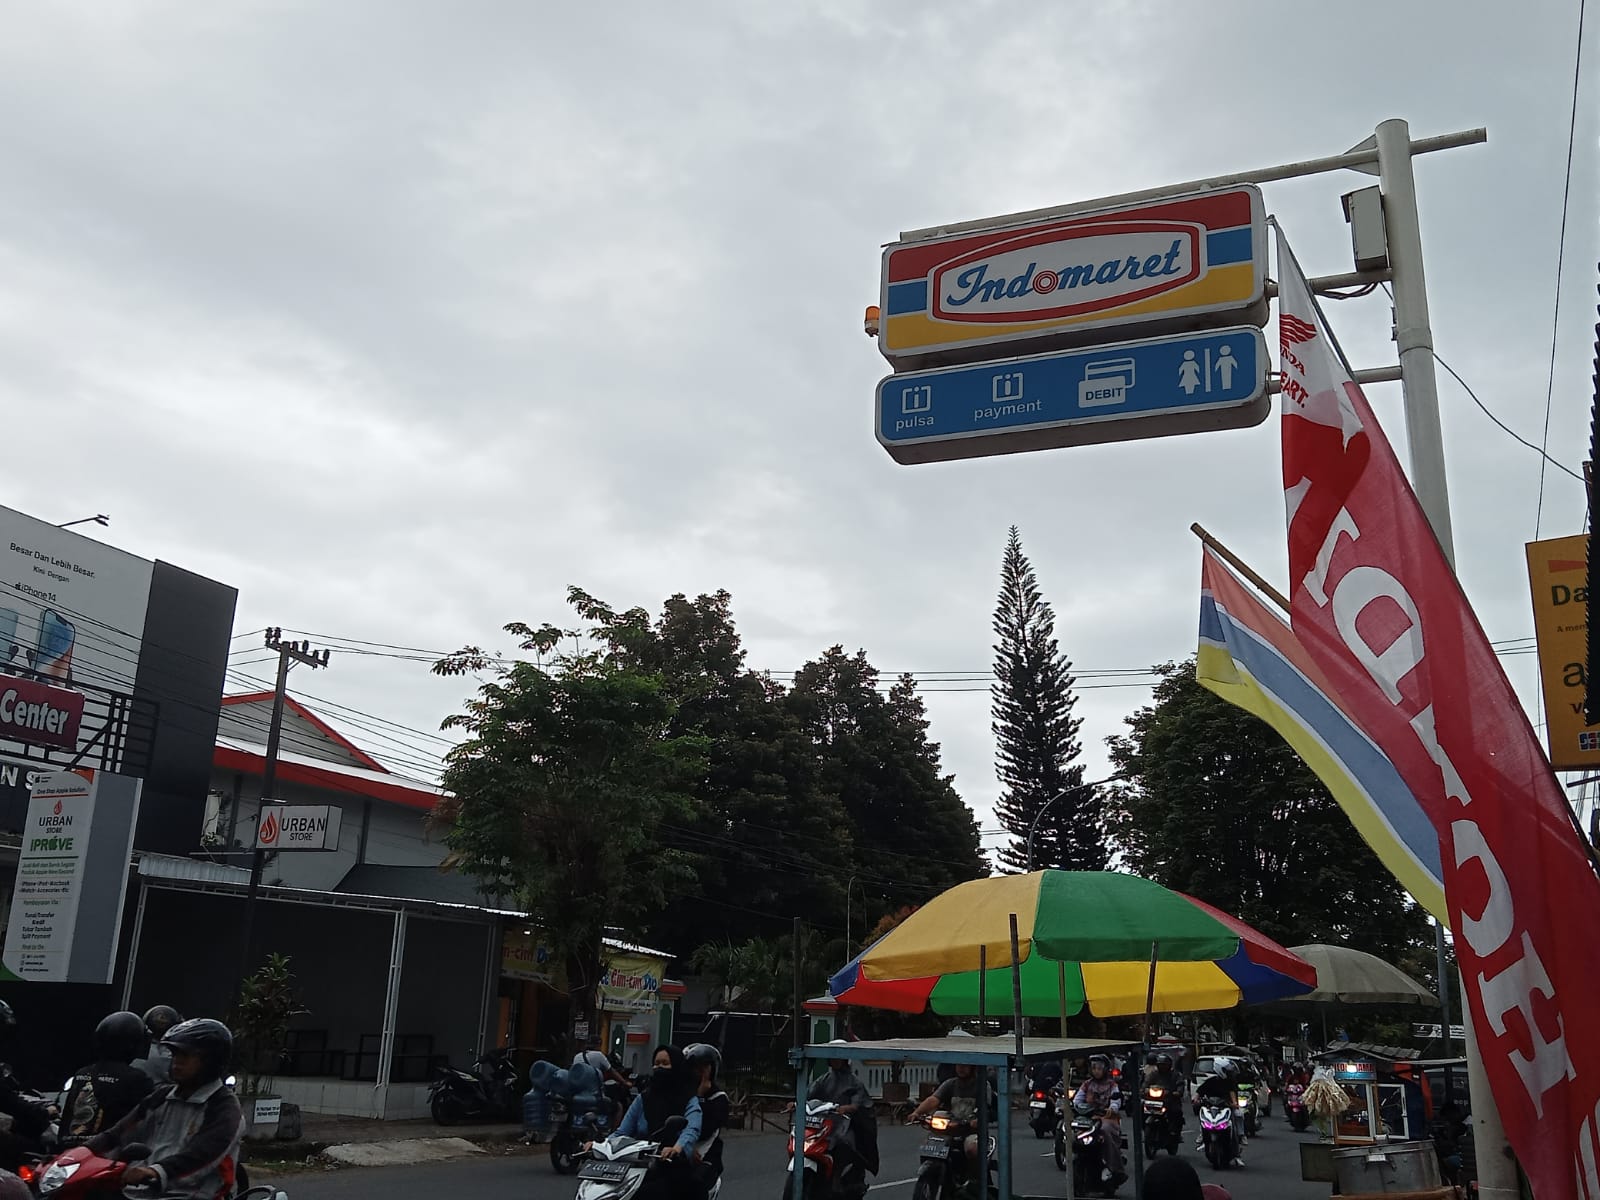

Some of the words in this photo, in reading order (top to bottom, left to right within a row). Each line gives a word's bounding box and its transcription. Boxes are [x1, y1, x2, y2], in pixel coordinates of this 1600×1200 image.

[946, 239, 1182, 307] Indomaret
[1085, 387, 1123, 401] DEBIT
[974, 399, 1042, 422] payment
[896, 415, 935, 432] pulsa
[9, 542, 34, 557] Besar
[34, 551, 50, 563] Dan
[50, 556, 72, 570] Lebih
[0, 689, 69, 735] Center
[39, 815, 73, 827] URBAN
[281, 818, 325, 832] URBAN
[289, 832, 313, 841] STORE
